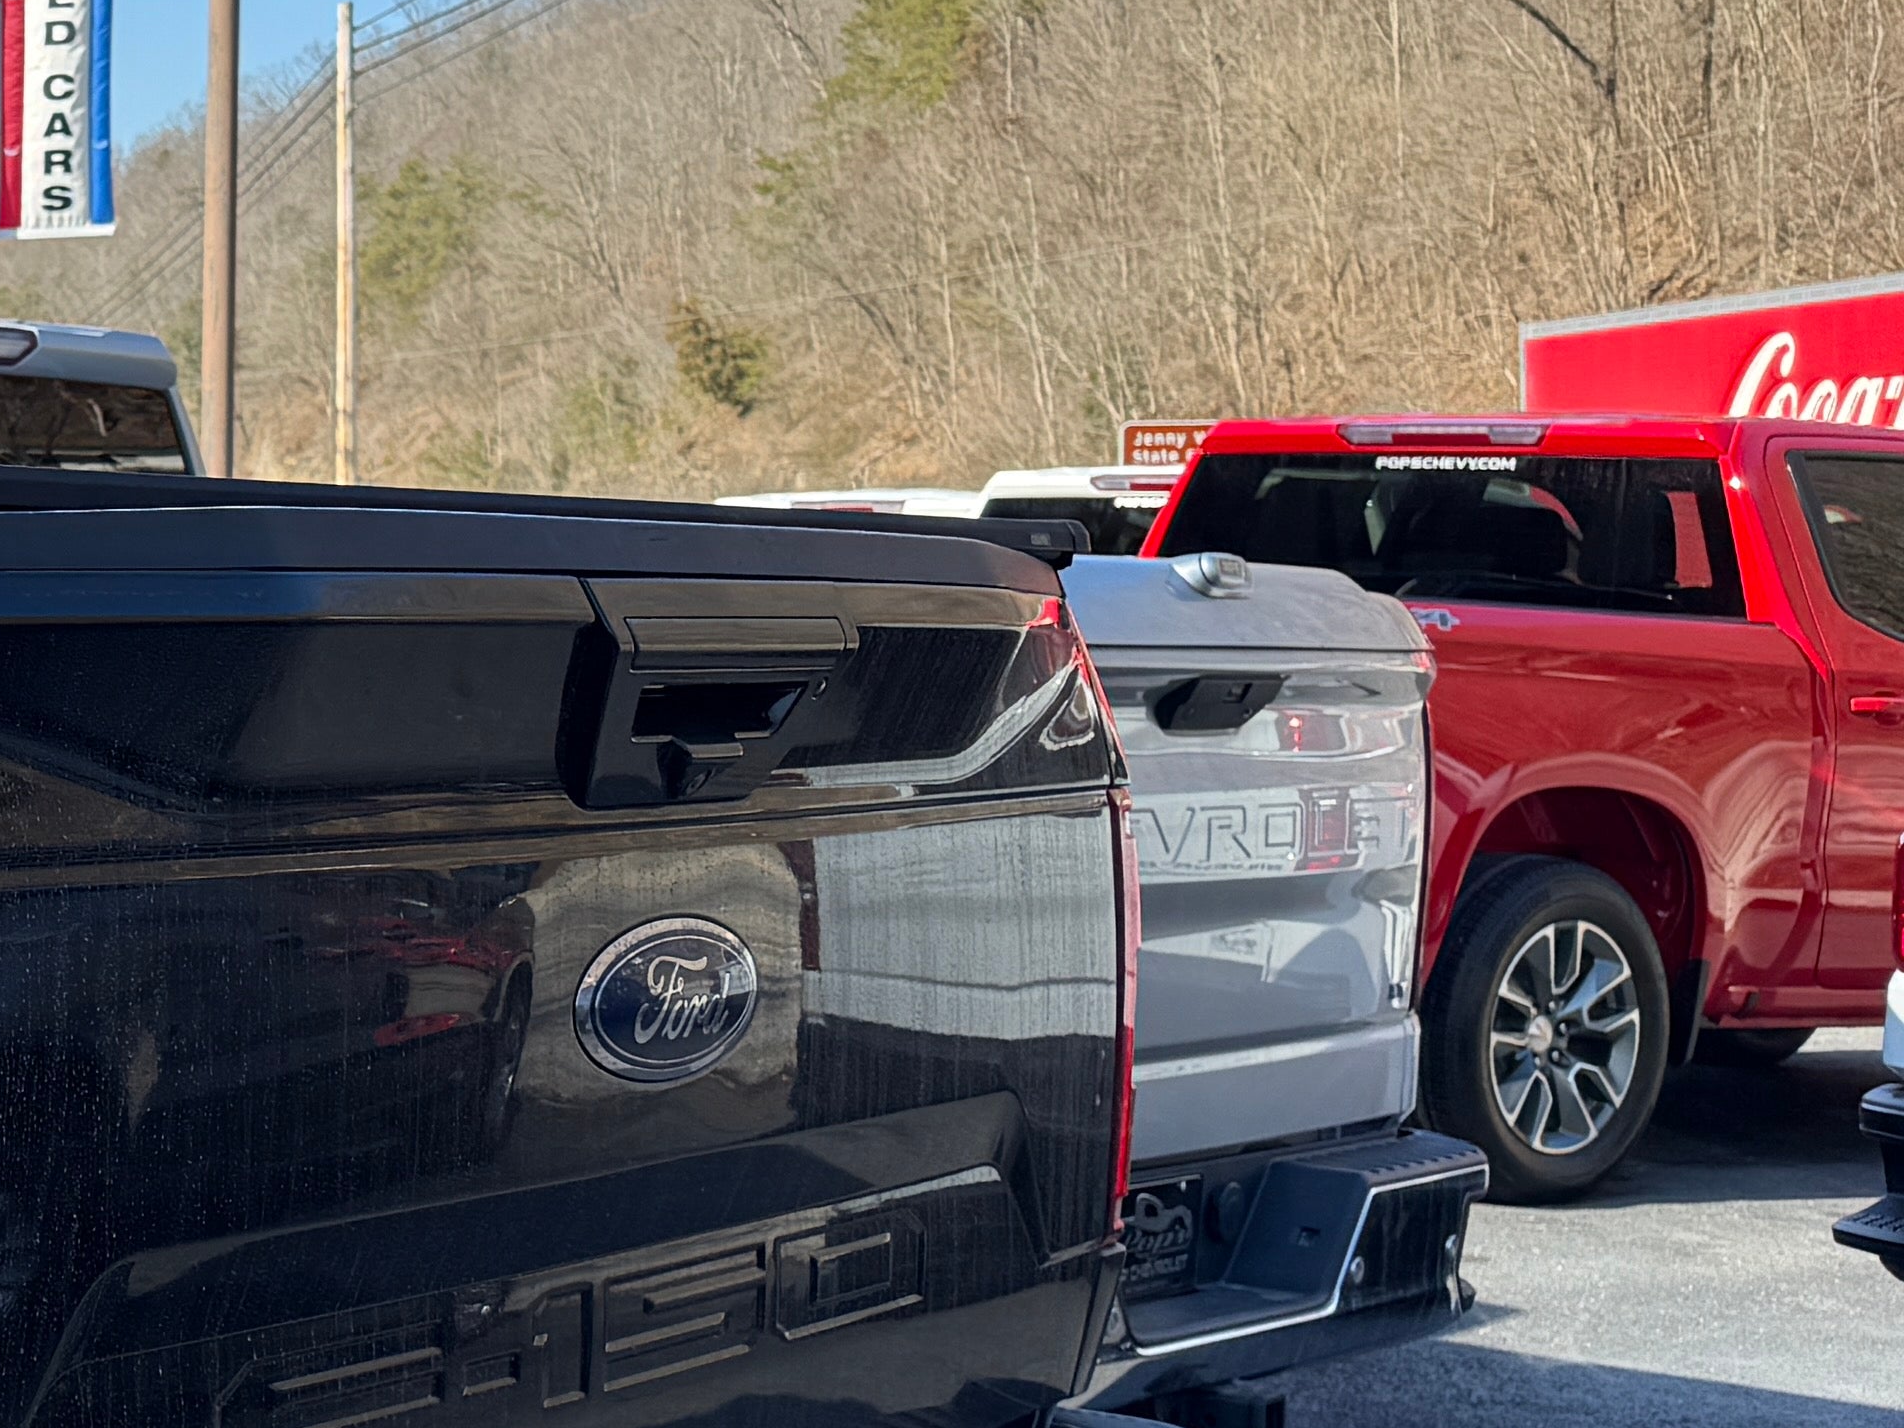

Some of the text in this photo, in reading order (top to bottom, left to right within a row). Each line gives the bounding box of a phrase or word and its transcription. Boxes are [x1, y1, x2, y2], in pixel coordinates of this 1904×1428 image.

[41, 73, 76, 212] CARS
[1132, 449, 1180, 464] State
[1133, 430, 1187, 449] Jenny
[633, 955, 729, 1045] Ford
